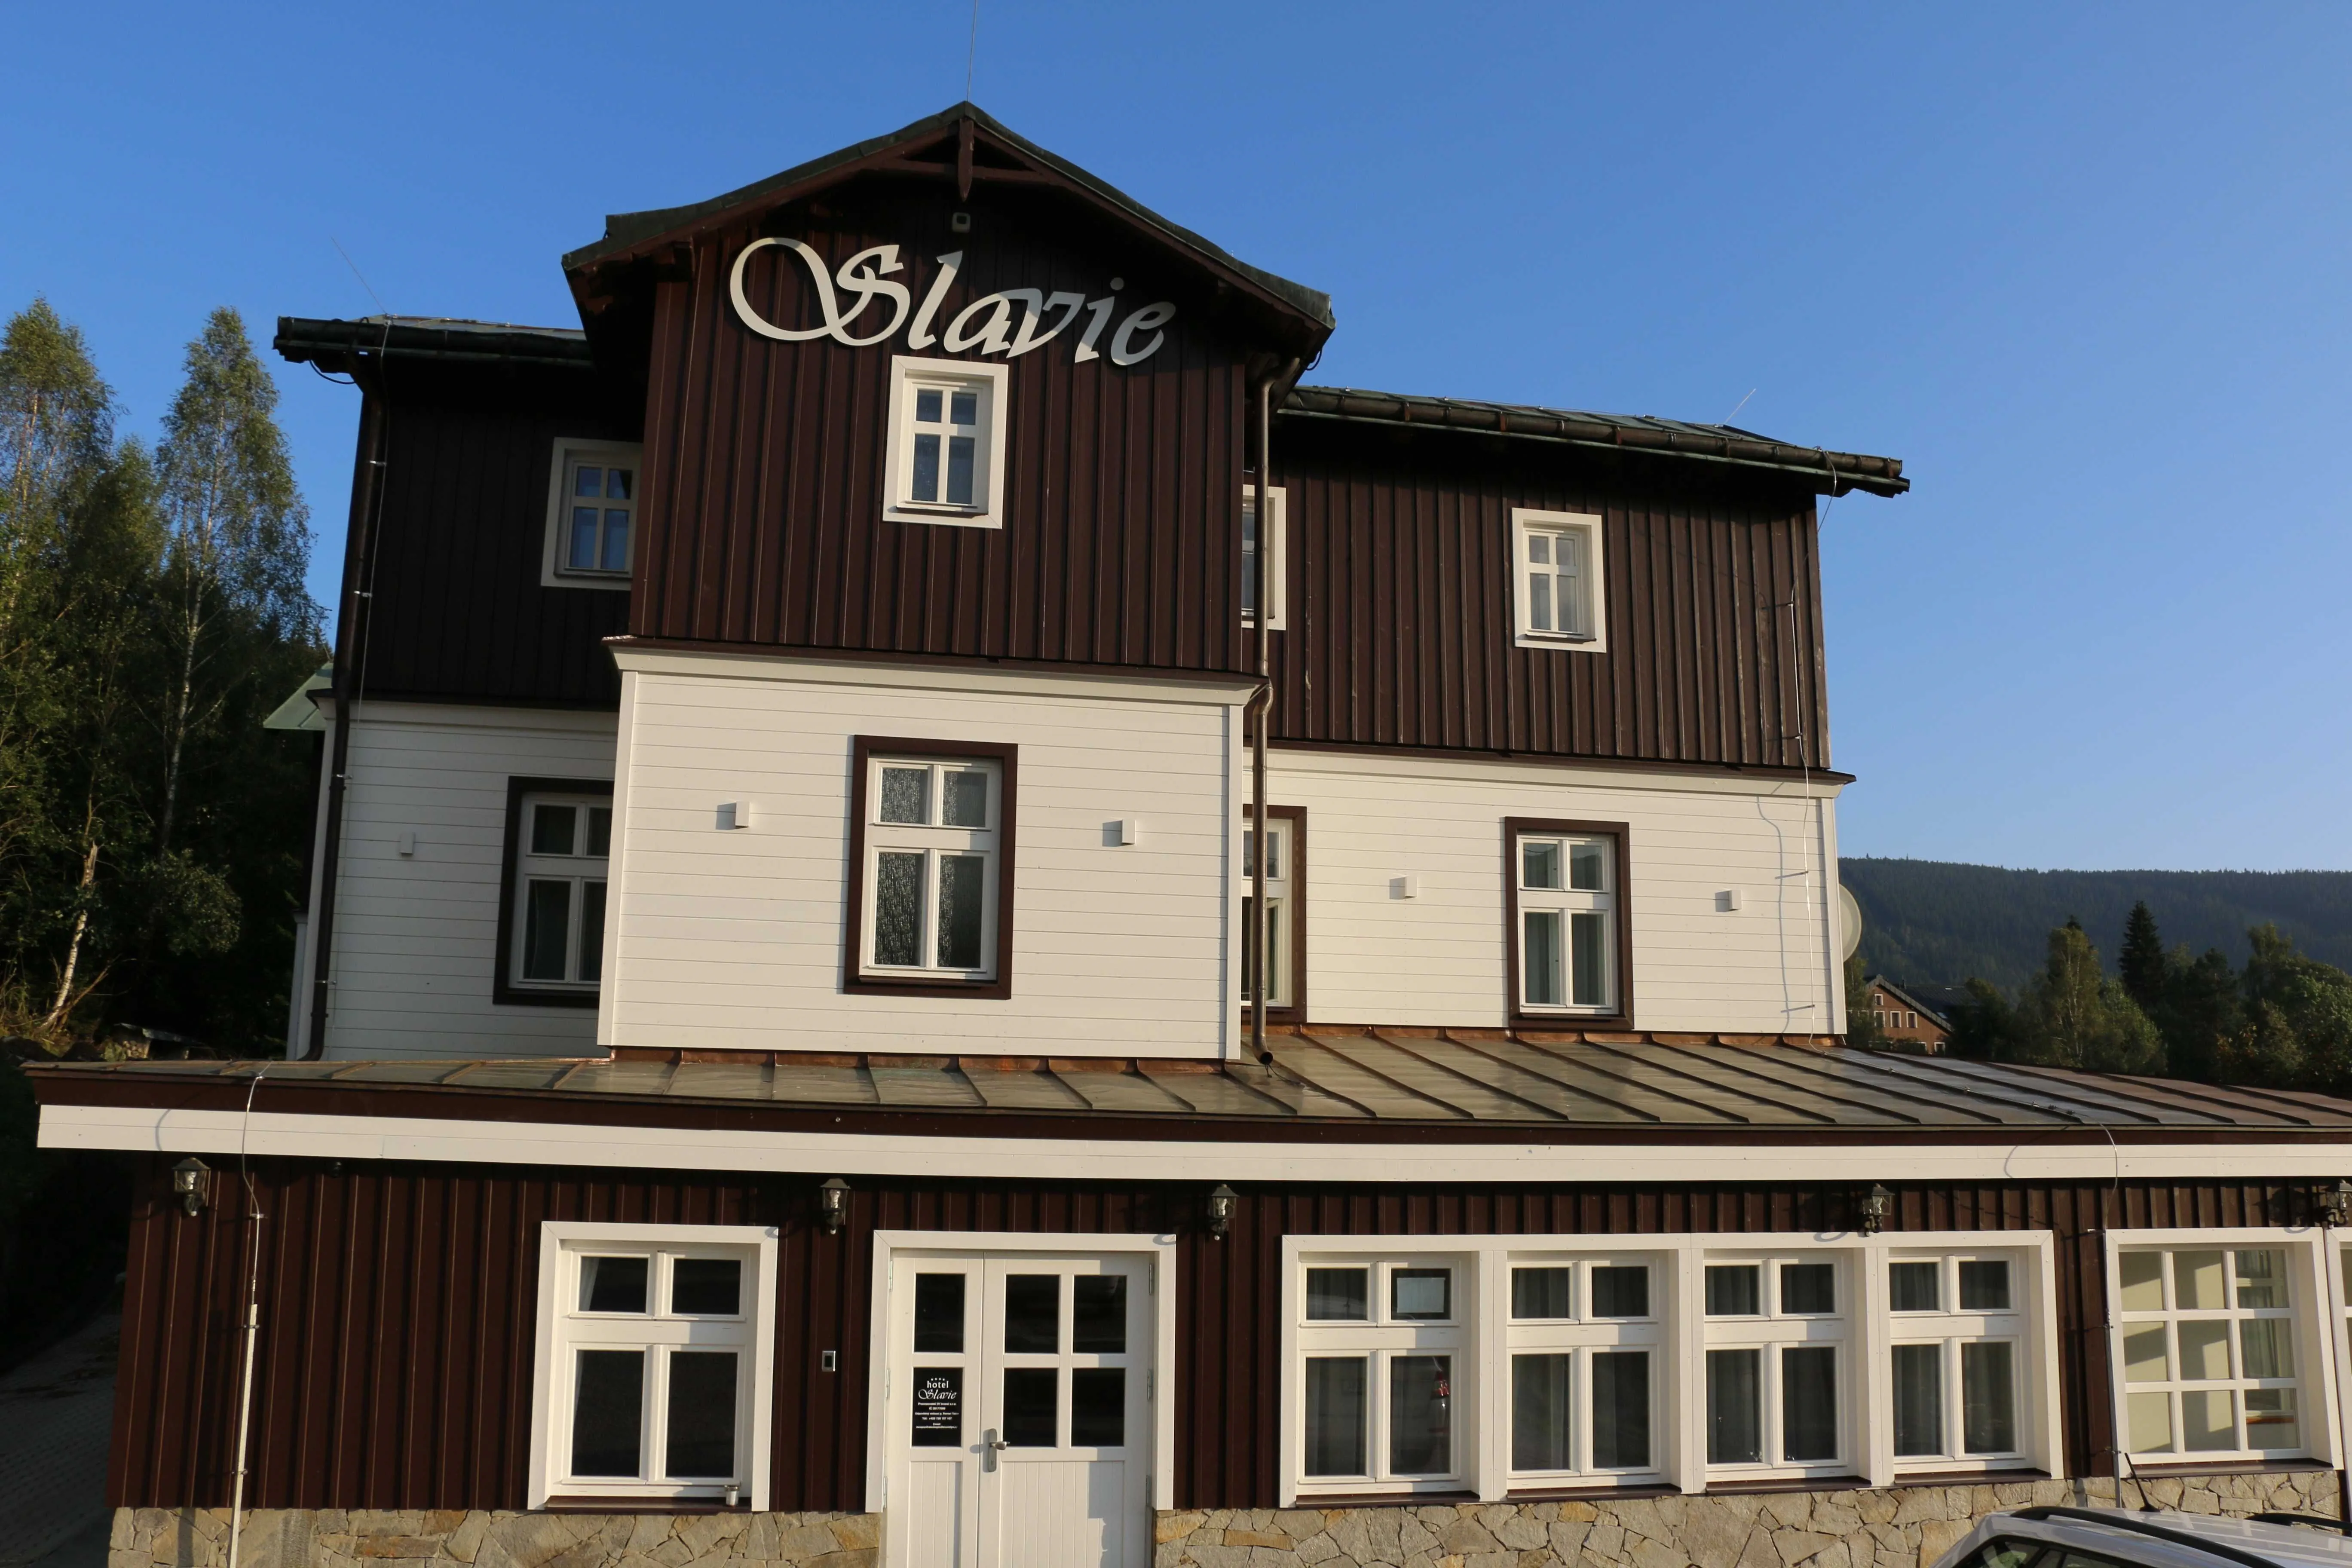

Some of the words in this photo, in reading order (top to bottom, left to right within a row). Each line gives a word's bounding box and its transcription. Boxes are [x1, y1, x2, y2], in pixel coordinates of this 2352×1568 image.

[730, 237, 1176, 366] Slavie
[927, 1380, 949, 1388] hotel
[918, 1389, 957, 1400] Slavie
